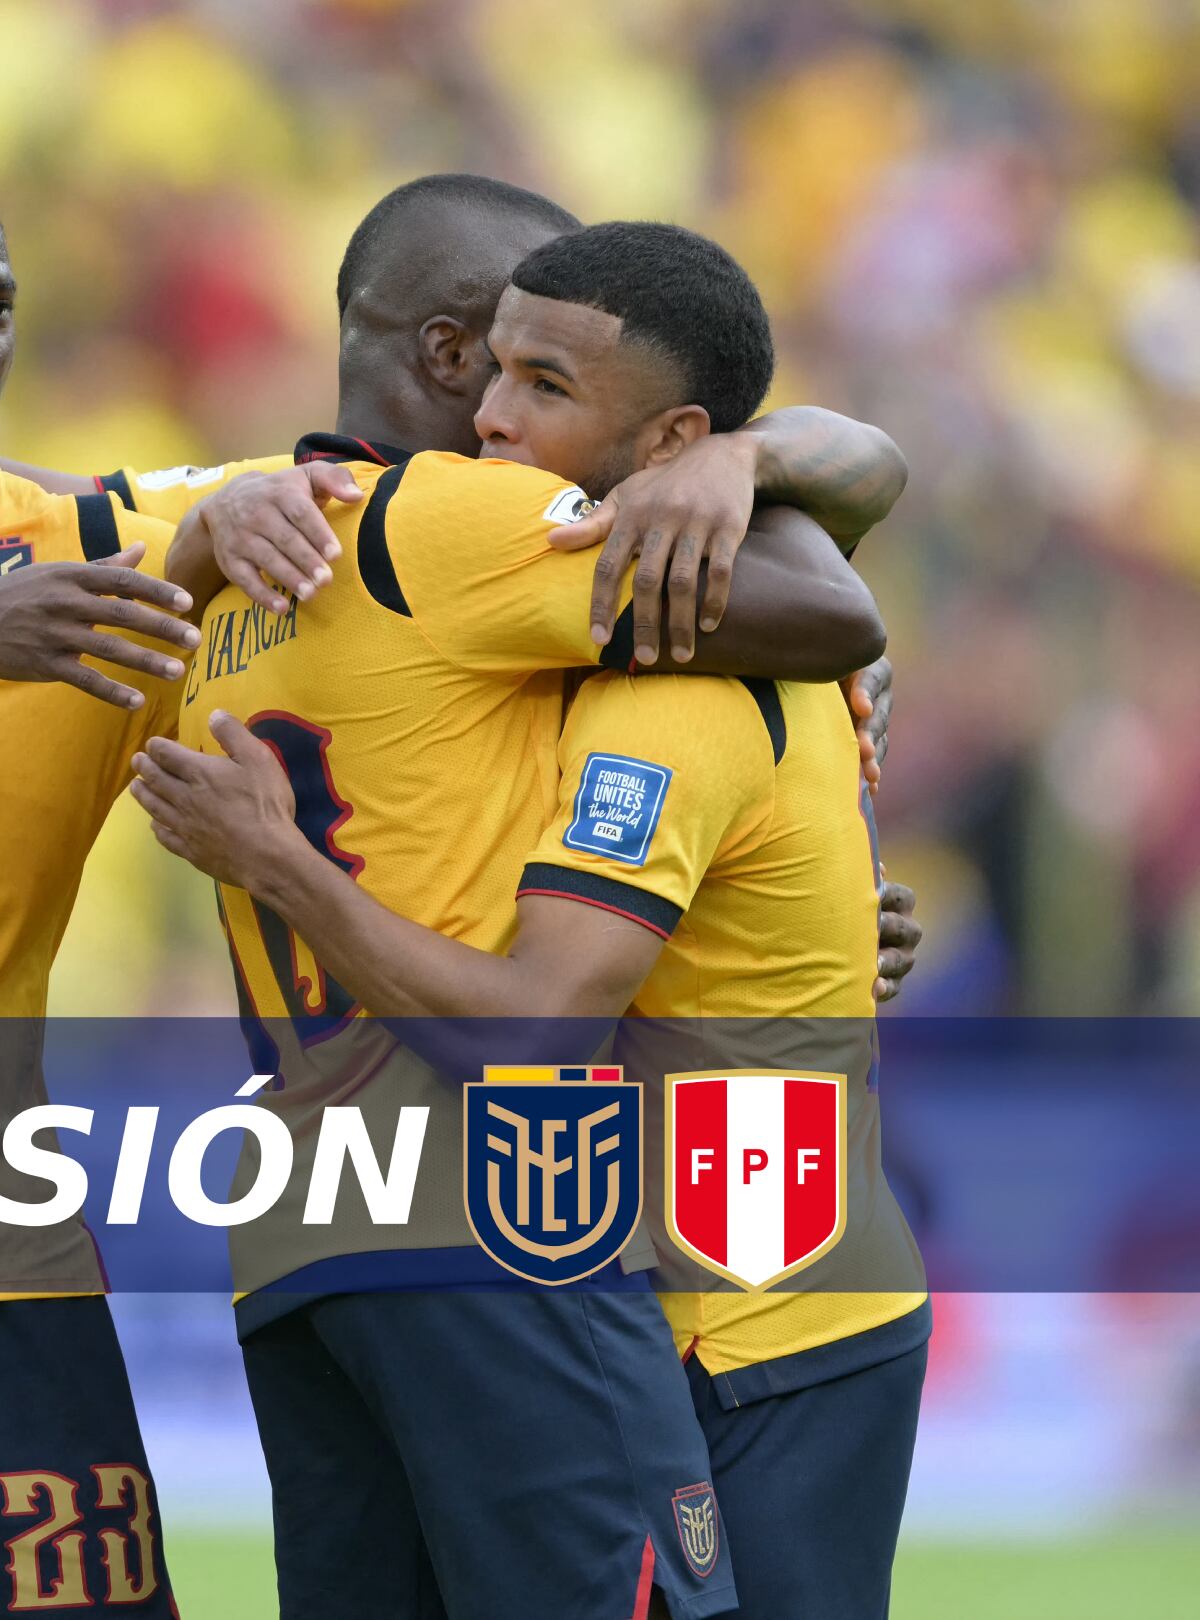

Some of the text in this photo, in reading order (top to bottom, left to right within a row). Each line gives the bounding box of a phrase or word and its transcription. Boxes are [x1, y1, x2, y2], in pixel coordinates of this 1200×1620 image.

[597, 769, 646, 793] FOOTBALL
[593, 783, 644, 811] UNITES
[588, 802, 643, 829] the World
[597, 825, 617, 837] FIFA
